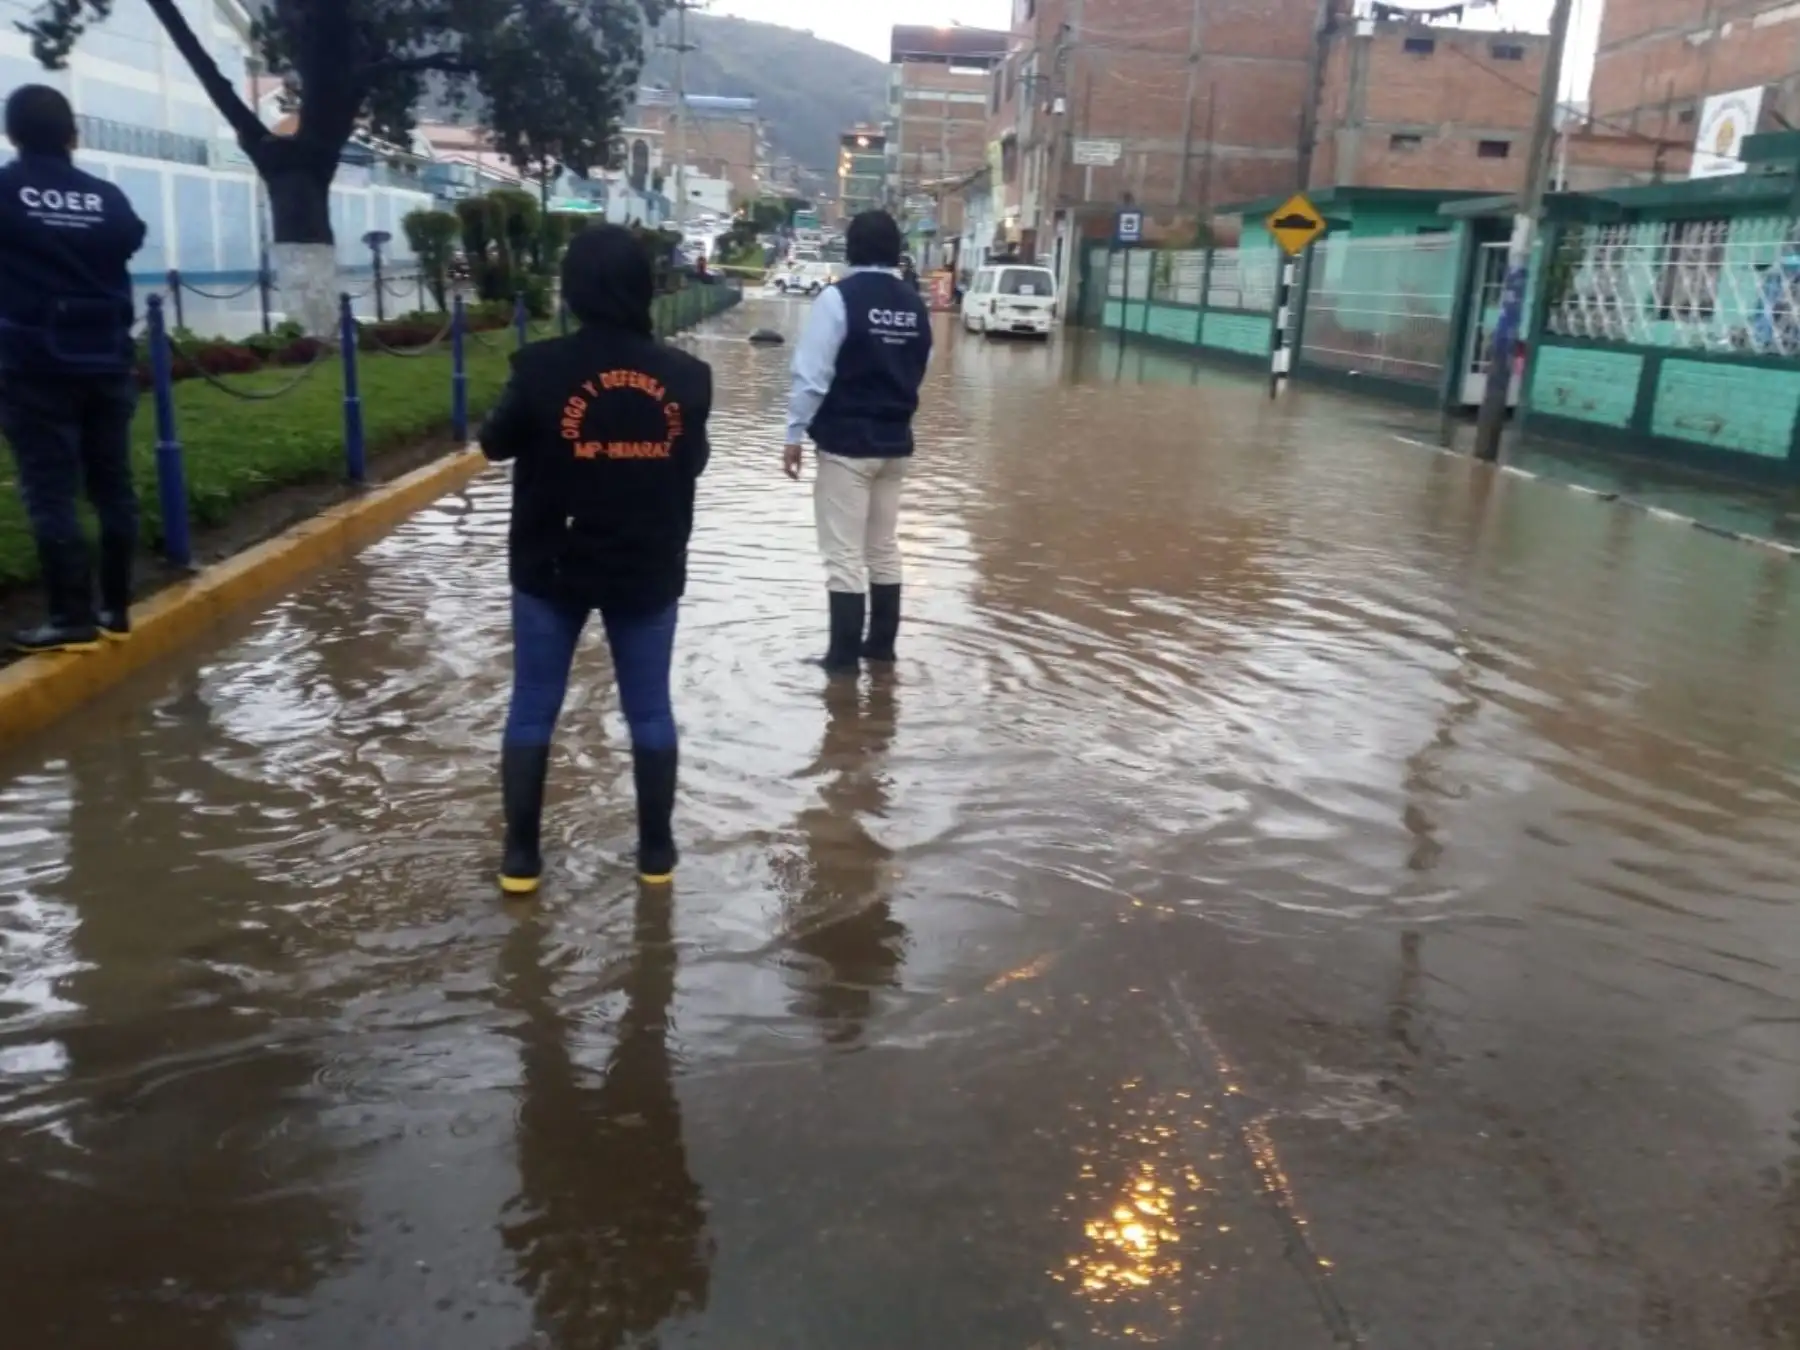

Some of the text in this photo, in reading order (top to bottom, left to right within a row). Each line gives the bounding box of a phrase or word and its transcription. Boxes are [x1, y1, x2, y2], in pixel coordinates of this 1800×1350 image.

[19, 186, 103, 212] COER
[867, 308, 918, 328] COER
[581, 380, 599, 398] Y
[599, 369, 666, 401] DEFENSA
